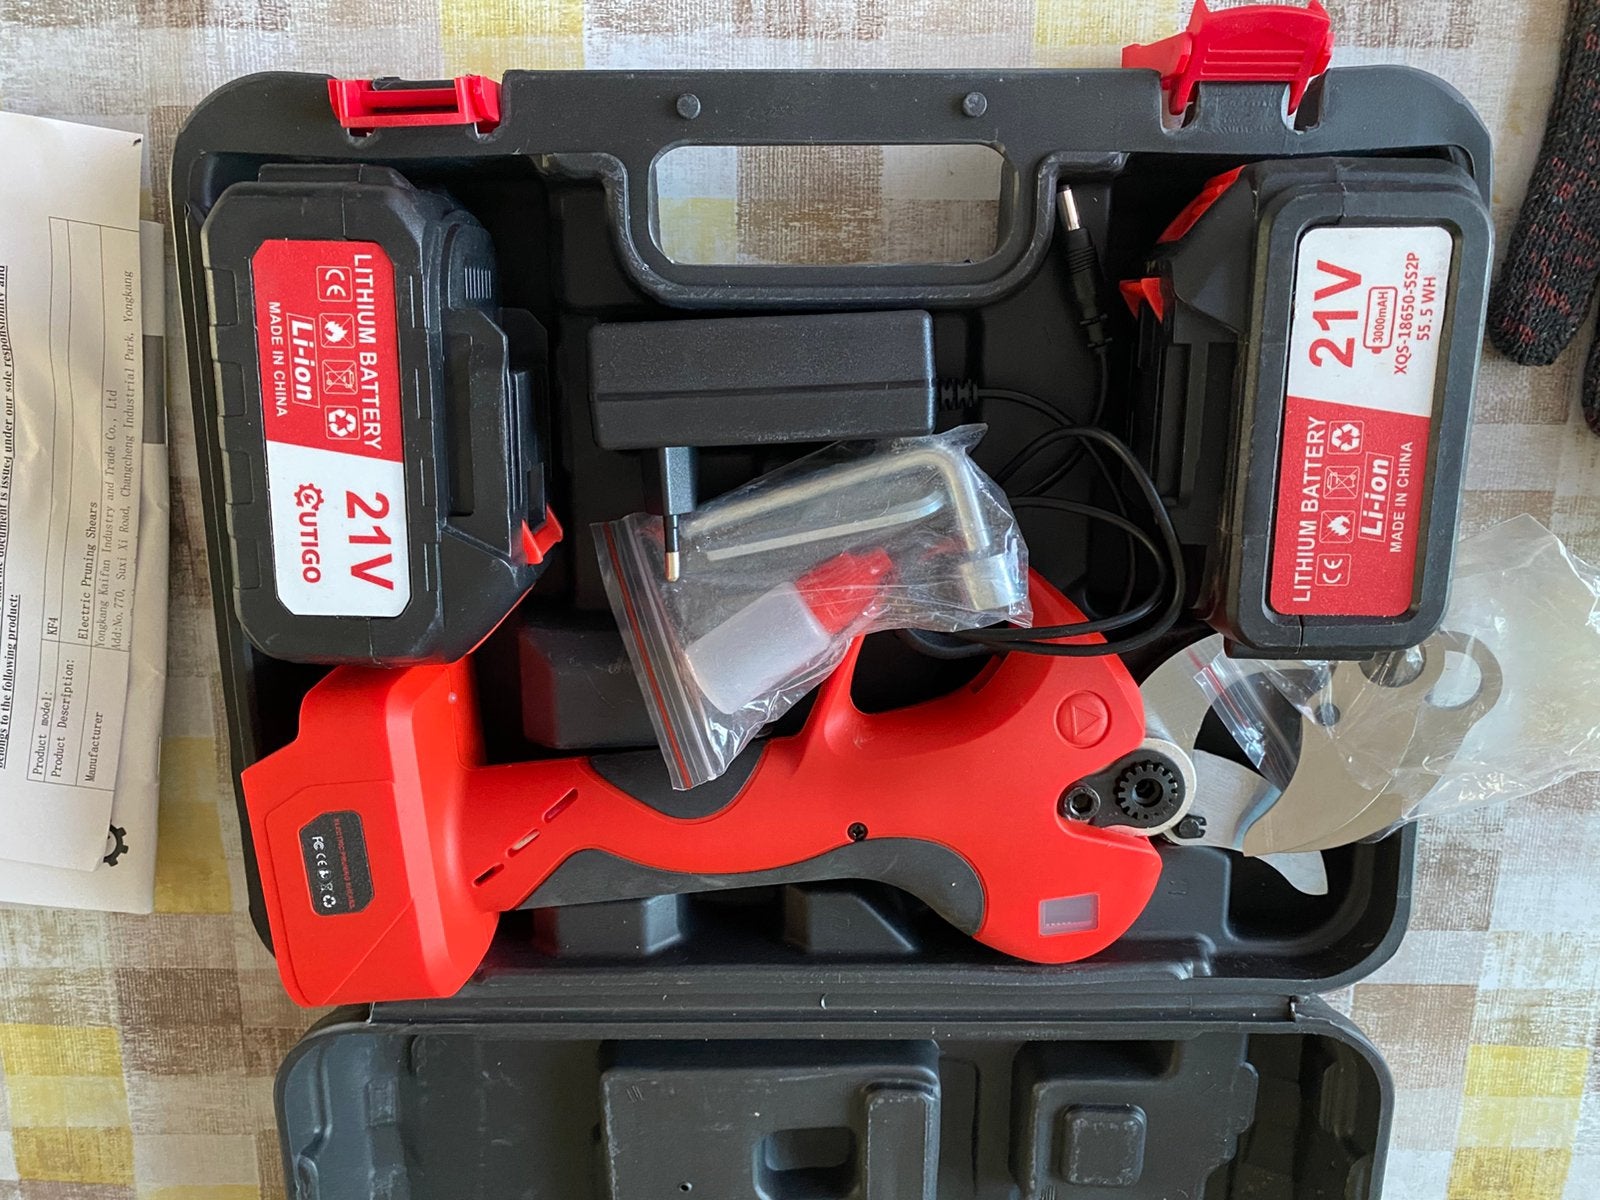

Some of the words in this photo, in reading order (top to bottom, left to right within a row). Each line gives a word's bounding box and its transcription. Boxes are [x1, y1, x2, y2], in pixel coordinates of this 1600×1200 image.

[123, 271, 134, 323] Yongkang
[354, 254, 376, 343] LITHIUM
[1422, 277, 1436, 304] WH
[269, 302, 282, 345] MADE
[1309, 260, 1362, 368] 21V
[1373, 291, 1389, 343] 3000mAH
[1419, 308, 1434, 341] 55.5
[272, 350, 284, 365] IN
[292, 320, 316, 400] Li-ion
[3, 371, 12, 392] sole
[107, 389, 117, 409] Ltd
[123, 368, 135, 429] Industrial
[274, 370, 288, 417] CHINA
[359, 351, 382, 451] BATTERY
[5, 396, 13, 415] our
[3, 419, 12, 452] under
[106, 446, 116, 476] Trade
[121, 436, 135, 497] Changcheng
[1302, 416, 1326, 512] BATTERY
[1397, 442, 1413, 487] CHINA
[104, 482, 115, 501] and
[1362, 458, 1389, 536] Li-ion
[1395, 493, 1407, 506] IN
[85, 502, 97, 539] Shears
[102, 506, 115, 553] Industry
[120, 506, 131, 533] Road,
[346, 490, 394, 590] 21V
[1390, 511, 1407, 552] MADE
[81, 544, 97, 587] Pruning
[118, 540, 128, 551] Xi
[1293, 519, 1318, 602] LITHIUM
[98, 559, 111, 596] Kaifan
[116, 556, 127, 580] Suxi
[8, 594, 19, 640] product:
[47, 617, 58, 635] KF4
[78, 592, 91, 639] Electric
[94, 600, 108, 648] Yongkang
[2, 643, 16, 691] following
[1, 695, 11, 711] the
[57, 659, 75, 728] Description:
[2, 715, 9, 725] to
[33, 734, 47, 775] Product
[41, 691, 52, 726] model:
[52, 737, 66, 777] Product
[85, 712, 103, 782] Manufacturer
